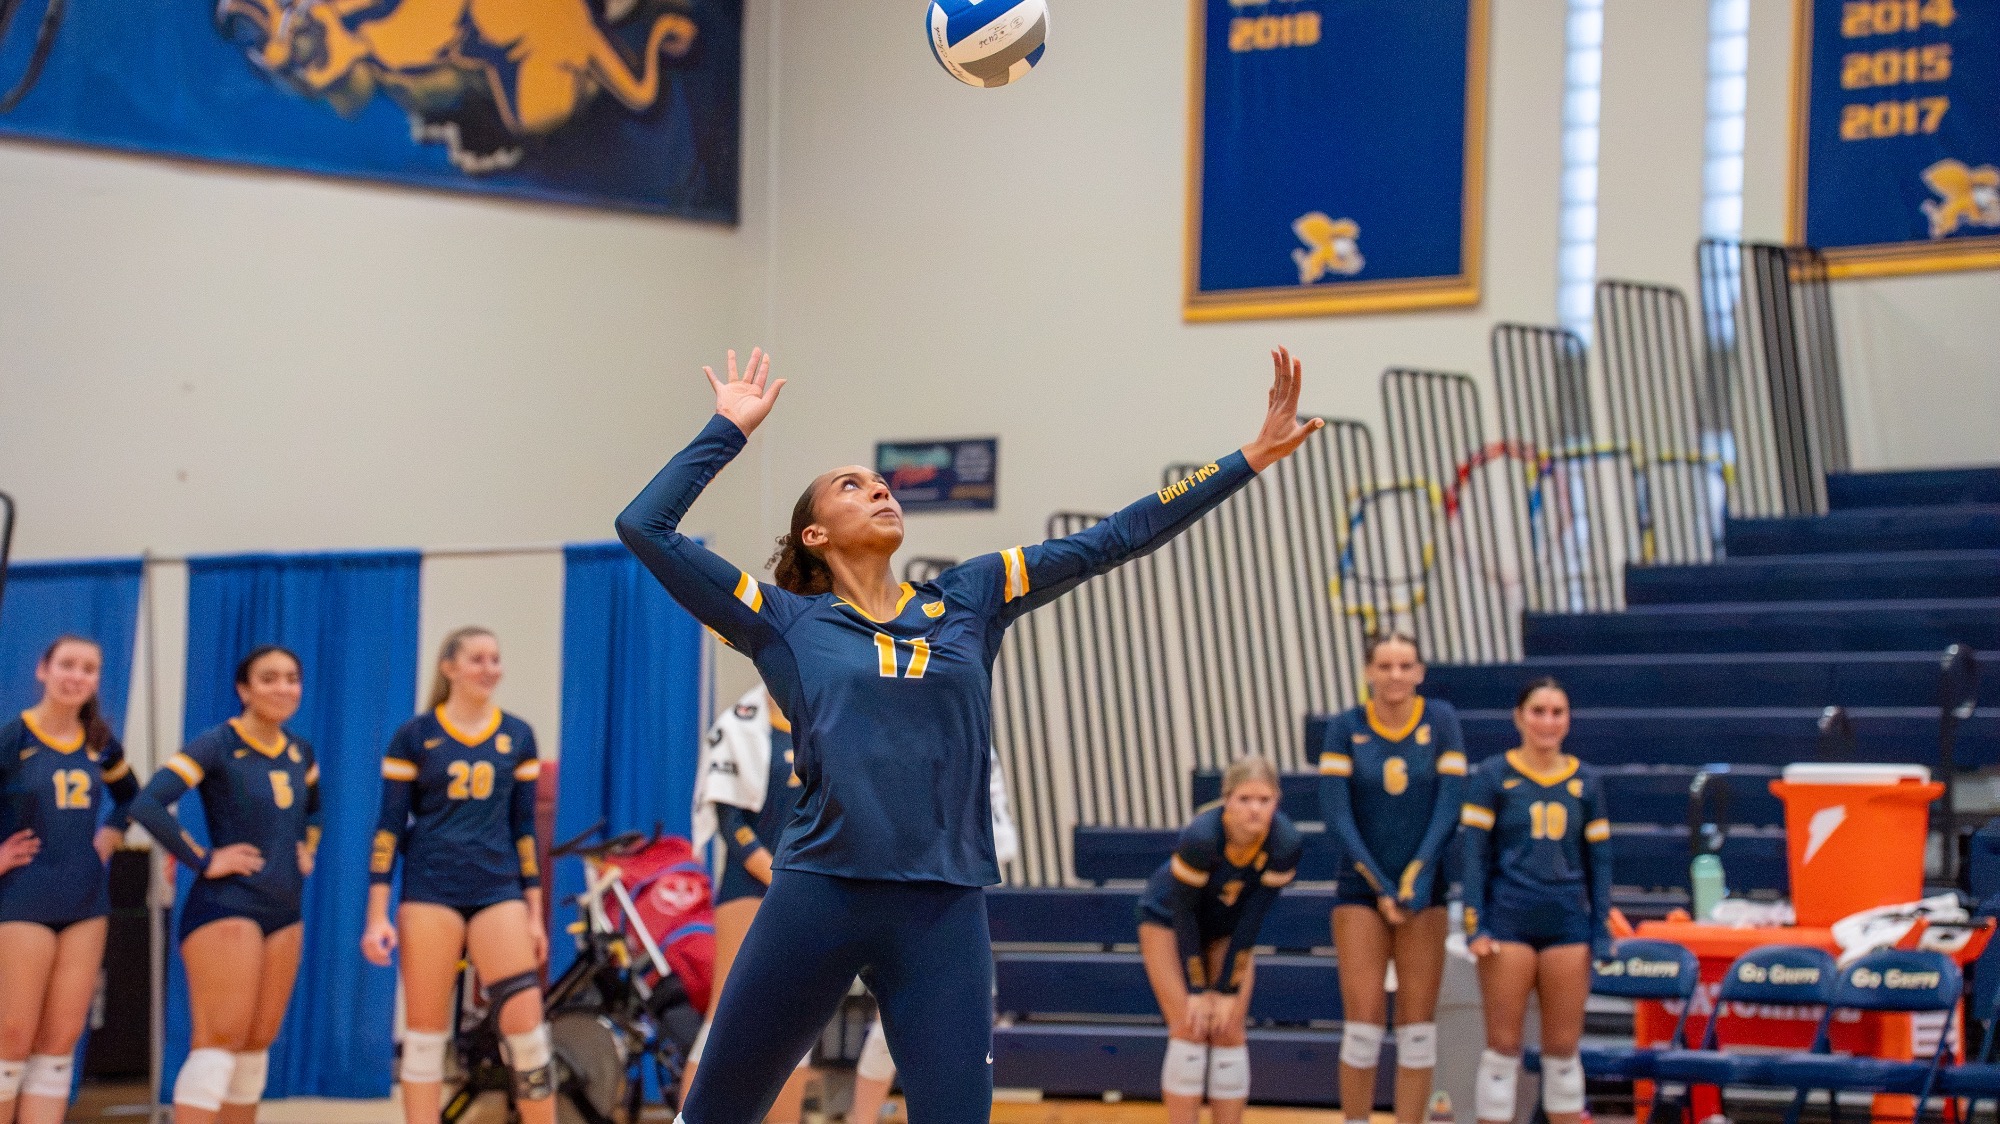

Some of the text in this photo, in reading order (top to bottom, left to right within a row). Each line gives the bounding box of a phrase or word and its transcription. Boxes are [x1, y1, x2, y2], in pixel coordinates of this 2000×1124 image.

[1840, 0, 1957, 38] 2014
[1840, 43, 1952, 90] 2015
[1840, 96, 1950, 142] 2017
[1157, 461, 1220, 505] GRIFFINS
[874, 632, 931, 678] 17
[52, 769, 92, 810] 12
[269, 770, 295, 810] 5
[447, 760, 496, 800] 20
[1383, 756, 1408, 795] 6
[1529, 801, 1568, 840] 10
